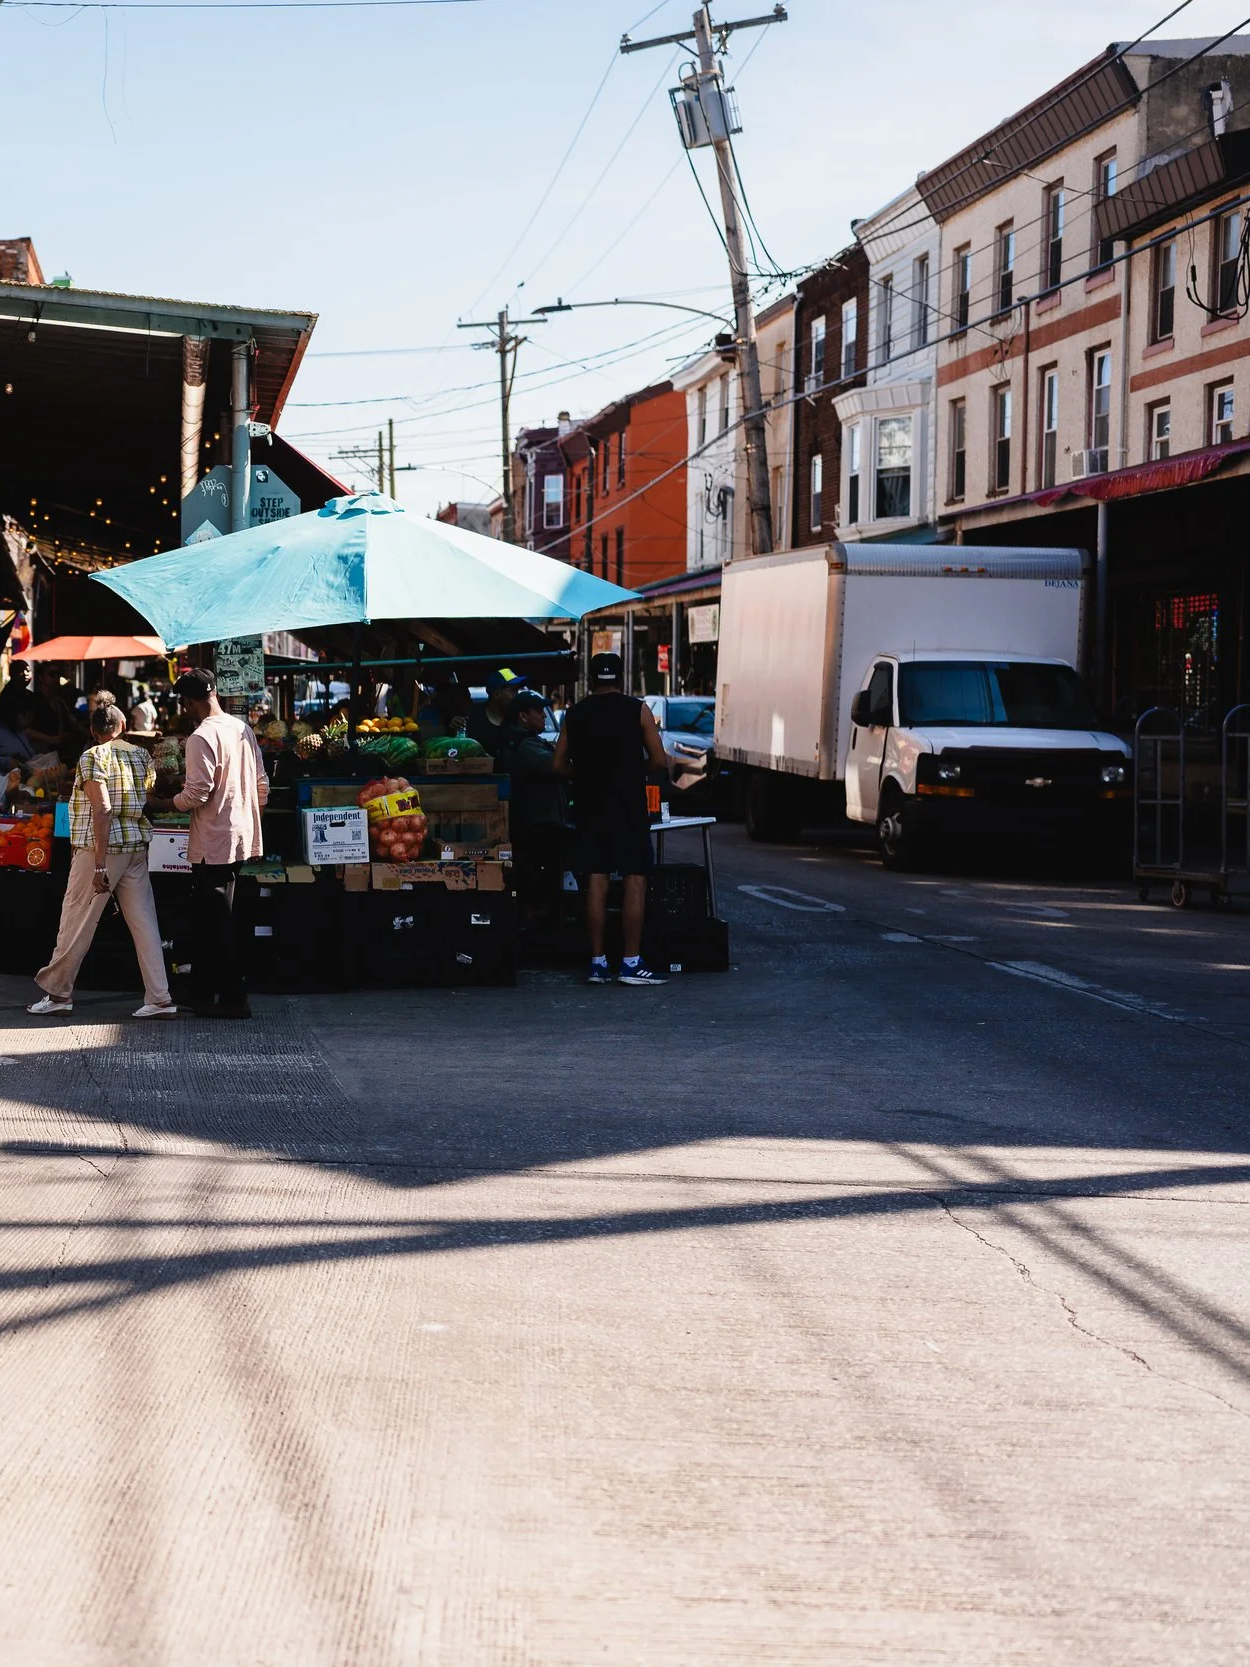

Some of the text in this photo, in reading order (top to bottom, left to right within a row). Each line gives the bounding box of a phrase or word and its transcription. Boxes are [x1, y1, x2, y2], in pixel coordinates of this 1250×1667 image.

[260, 497, 283, 508] STEP
[252, 507, 291, 518] OUTSIDE
[1044, 580, 1079, 589] DEJANA
[313, 811, 362, 823] Independent
[162, 863, 190, 871] lantains
[444, 869, 461, 878] Dole
